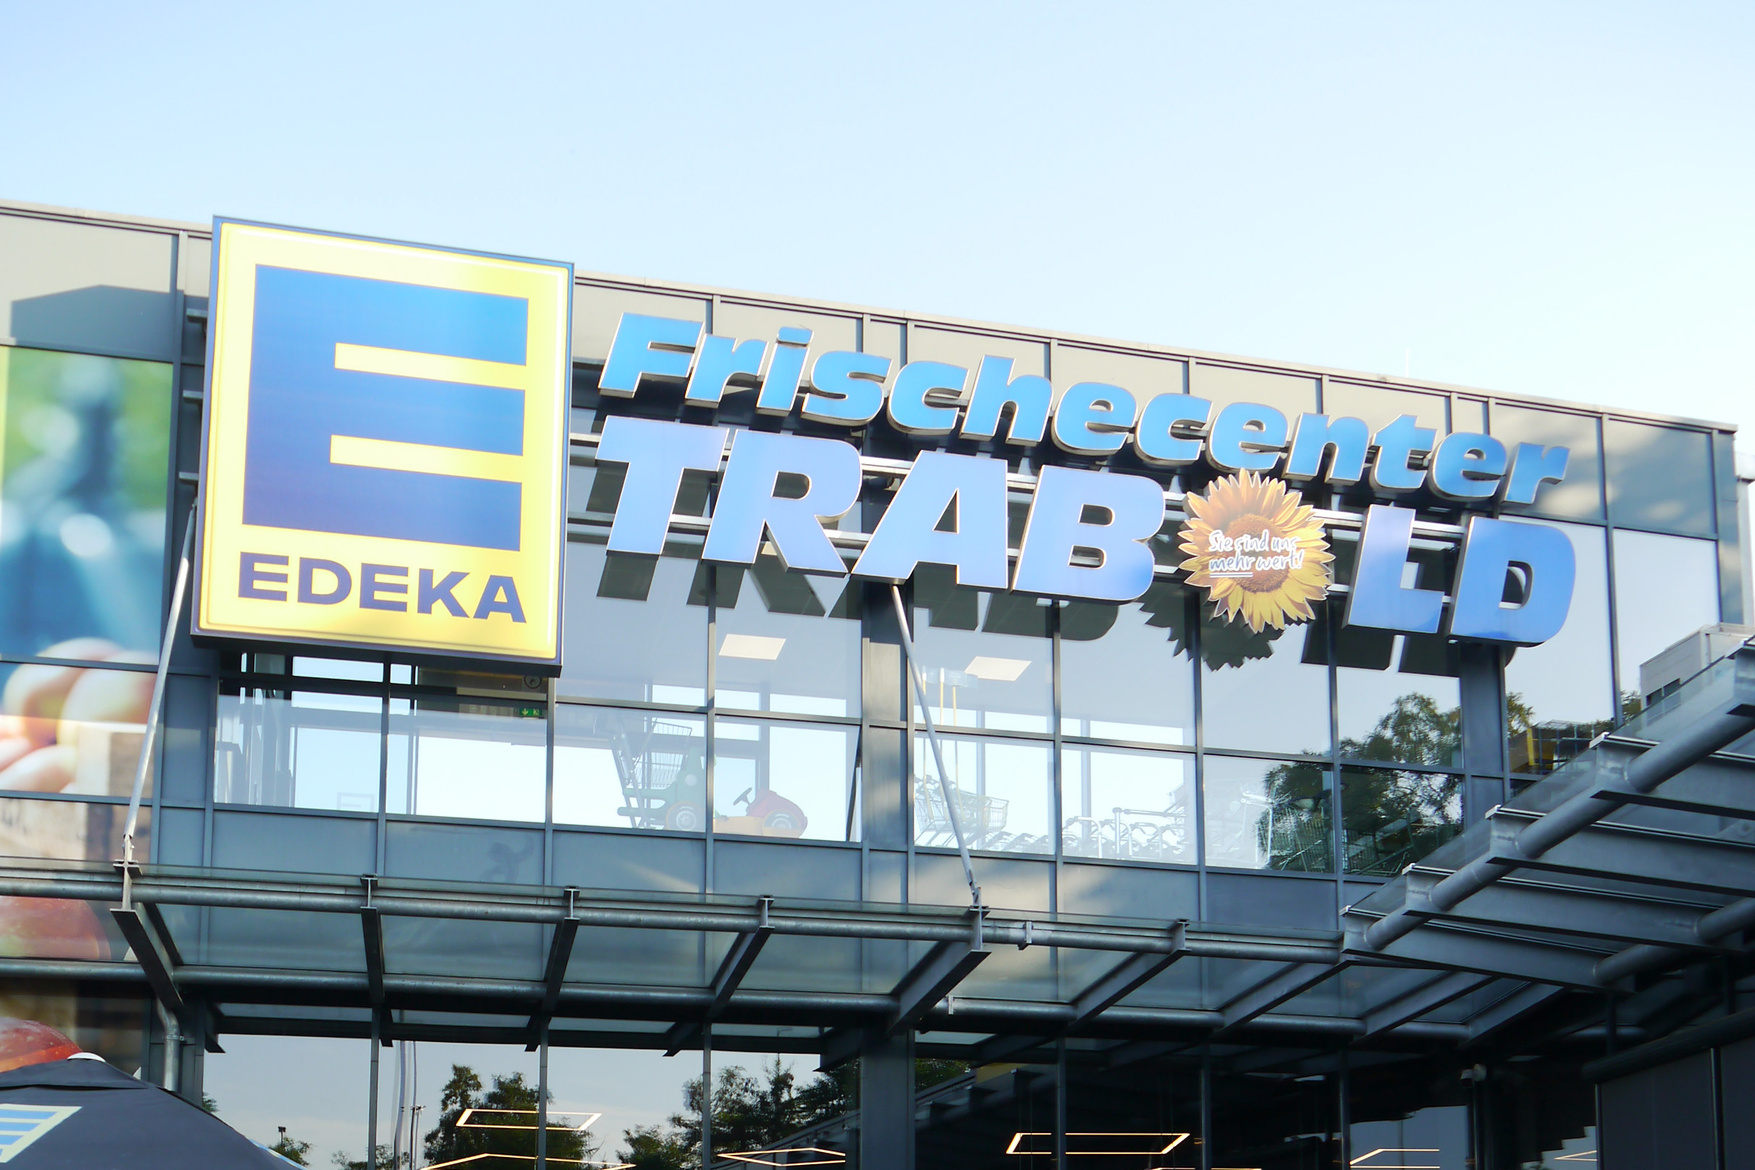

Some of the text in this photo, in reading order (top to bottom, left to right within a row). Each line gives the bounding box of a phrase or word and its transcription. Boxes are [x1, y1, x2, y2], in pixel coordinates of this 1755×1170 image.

[597, 312, 1571, 504] Frischecenter
[1208, 528, 1301, 553] Sie sind uns
[1209, 548, 1305, 572] mehr wert!
[238, 551, 527, 624] EDEKA
